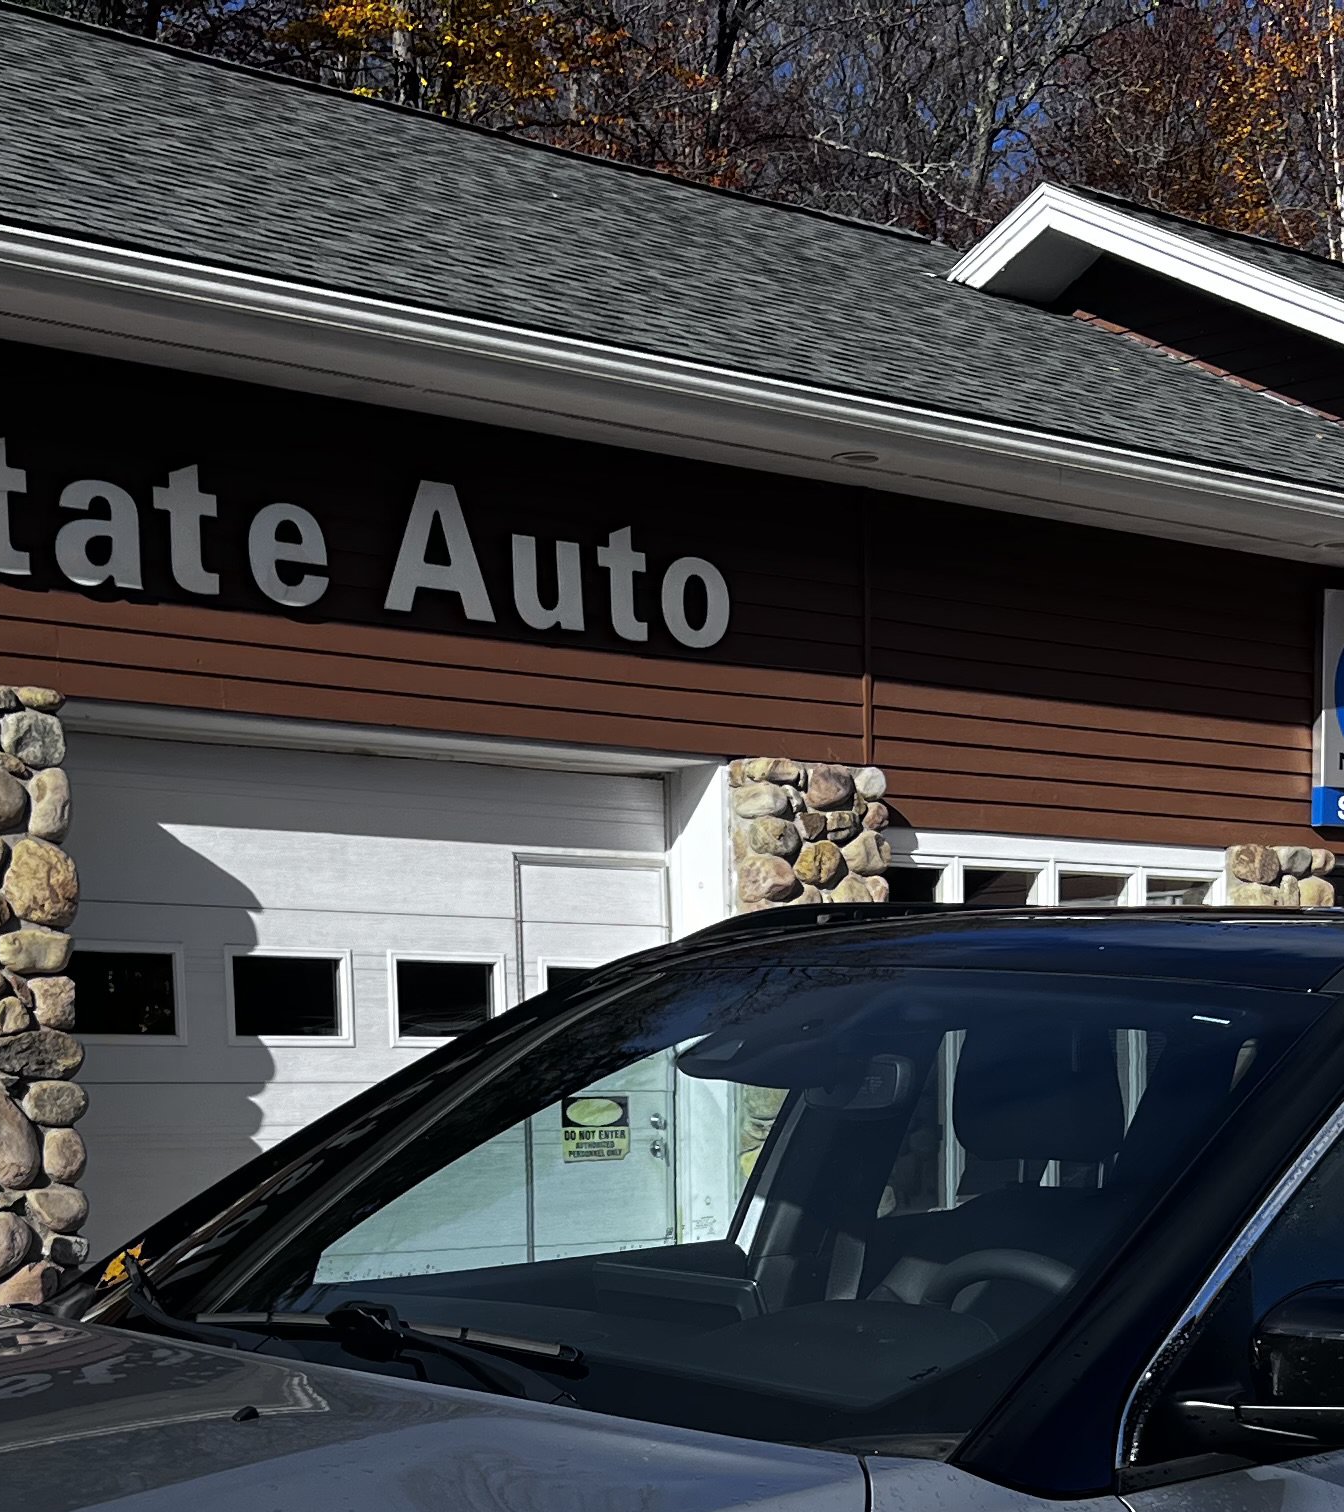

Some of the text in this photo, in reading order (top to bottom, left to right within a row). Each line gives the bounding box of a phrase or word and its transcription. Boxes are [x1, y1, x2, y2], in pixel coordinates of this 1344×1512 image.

[383, 479, 733, 649] Auto
[564, 1129, 626, 1141] DO NOT ENTER
